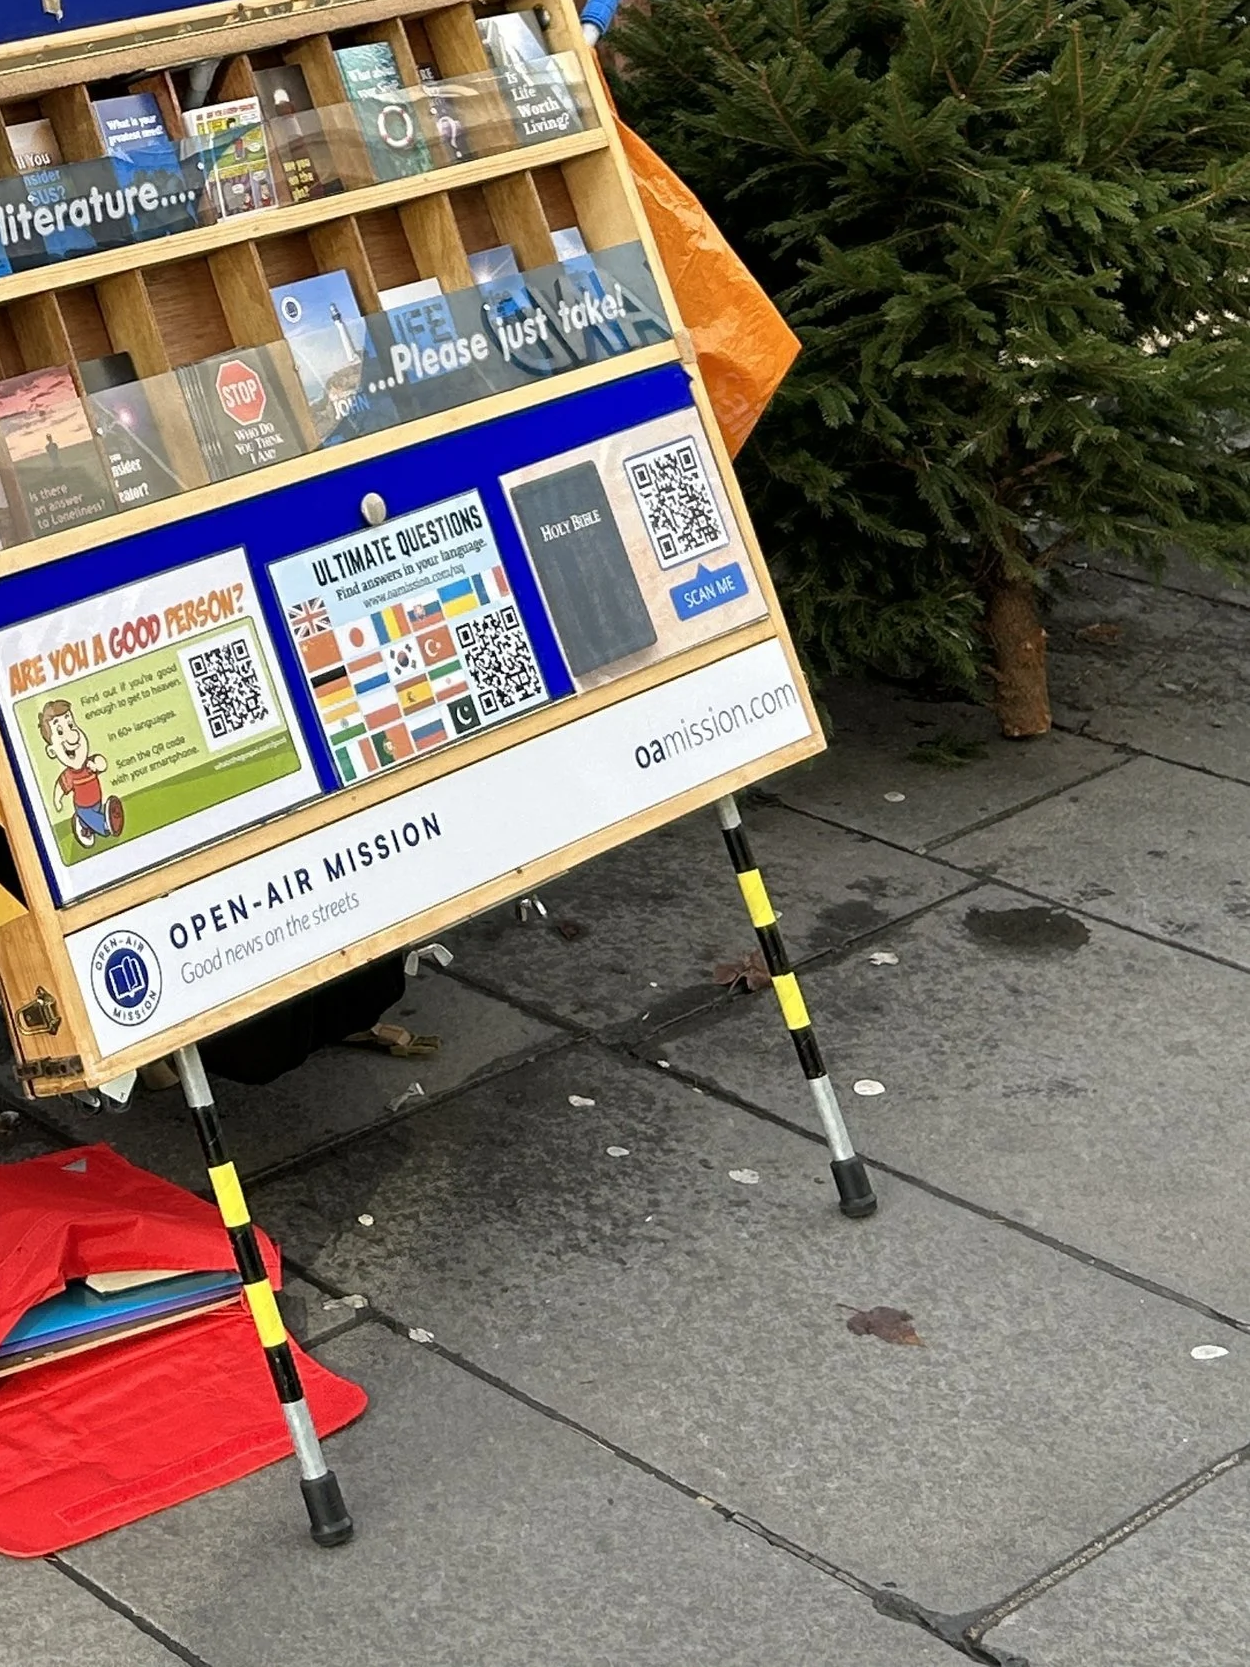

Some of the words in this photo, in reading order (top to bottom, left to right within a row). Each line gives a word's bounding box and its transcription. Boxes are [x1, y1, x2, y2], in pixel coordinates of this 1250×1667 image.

[505, 72, 518, 84] Is
[511, 84, 536, 101] Life
[517, 97, 560, 117] Worth
[106, 119, 130, 131] What
[138, 115, 157, 128] your
[523, 113, 569, 135] Living?
[27, 152, 50, 167] You
[496, 308, 548, 362] just
[558, 283, 627, 334] take!
[222, 379, 257, 408] STOP
[333, 393, 370, 420] JOHN
[234, 428, 258, 441] WHO
[259, 423, 274, 435] DO
[235, 442, 254, 455] YOU
[255, 433, 284, 449] THINK
[29, 492, 38, 502] Is
[40, 484, 68, 499] there
[34, 505, 47, 516] an
[50, 494, 83, 512] answer
[38, 519, 49, 529] to
[541, 520, 571, 542] HOLY
[571, 509, 601, 532] BIBLE
[312, 536, 396, 587] ULTIMATE
[397, 505, 483, 555] QUESTIONS
[336, 582, 360, 601] Find
[362, 568, 402, 591] answers
[404, 564, 415, 576] in
[416, 556, 439, 573] your
[684, 582, 716, 609] SCAN
[717, 575, 735, 594] ME
[9, 654, 46, 698] ARE
[49, 642, 88, 680] YOU
[92, 633, 107, 666] A
[108, 614, 160, 659] GOOD
[164, 583, 244, 639] PERSON?
[80, 693, 99, 706] Find
[103, 687, 118, 698] out
[120, 682, 126, 691] if
[157, 664, 177, 679] good
[85, 702, 117, 720] enough
[118, 699, 126, 707] to
[127, 694, 141, 705] get
[142, 690, 151, 698] to
[635, 683, 797, 769] oamission.com
[116, 756, 136, 769] Scan
[136, 750, 150, 761] the
[152, 743, 164, 755] QR
[166, 736, 185, 749] code
[111, 773, 129, 786] with
[130, 766, 148, 781] your
[169, 868, 314, 949] OPEN-AIR
[323, 812, 442, 882] MISSION
[181, 953, 223, 985] Good
[226, 936, 263, 969] news
[266, 927, 285, 948] on
[286, 913, 310, 936] the
[313, 891, 360, 925] streets
[96, 936, 144, 971] OPEN-AIR
[113, 990, 157, 1021] MISSION
